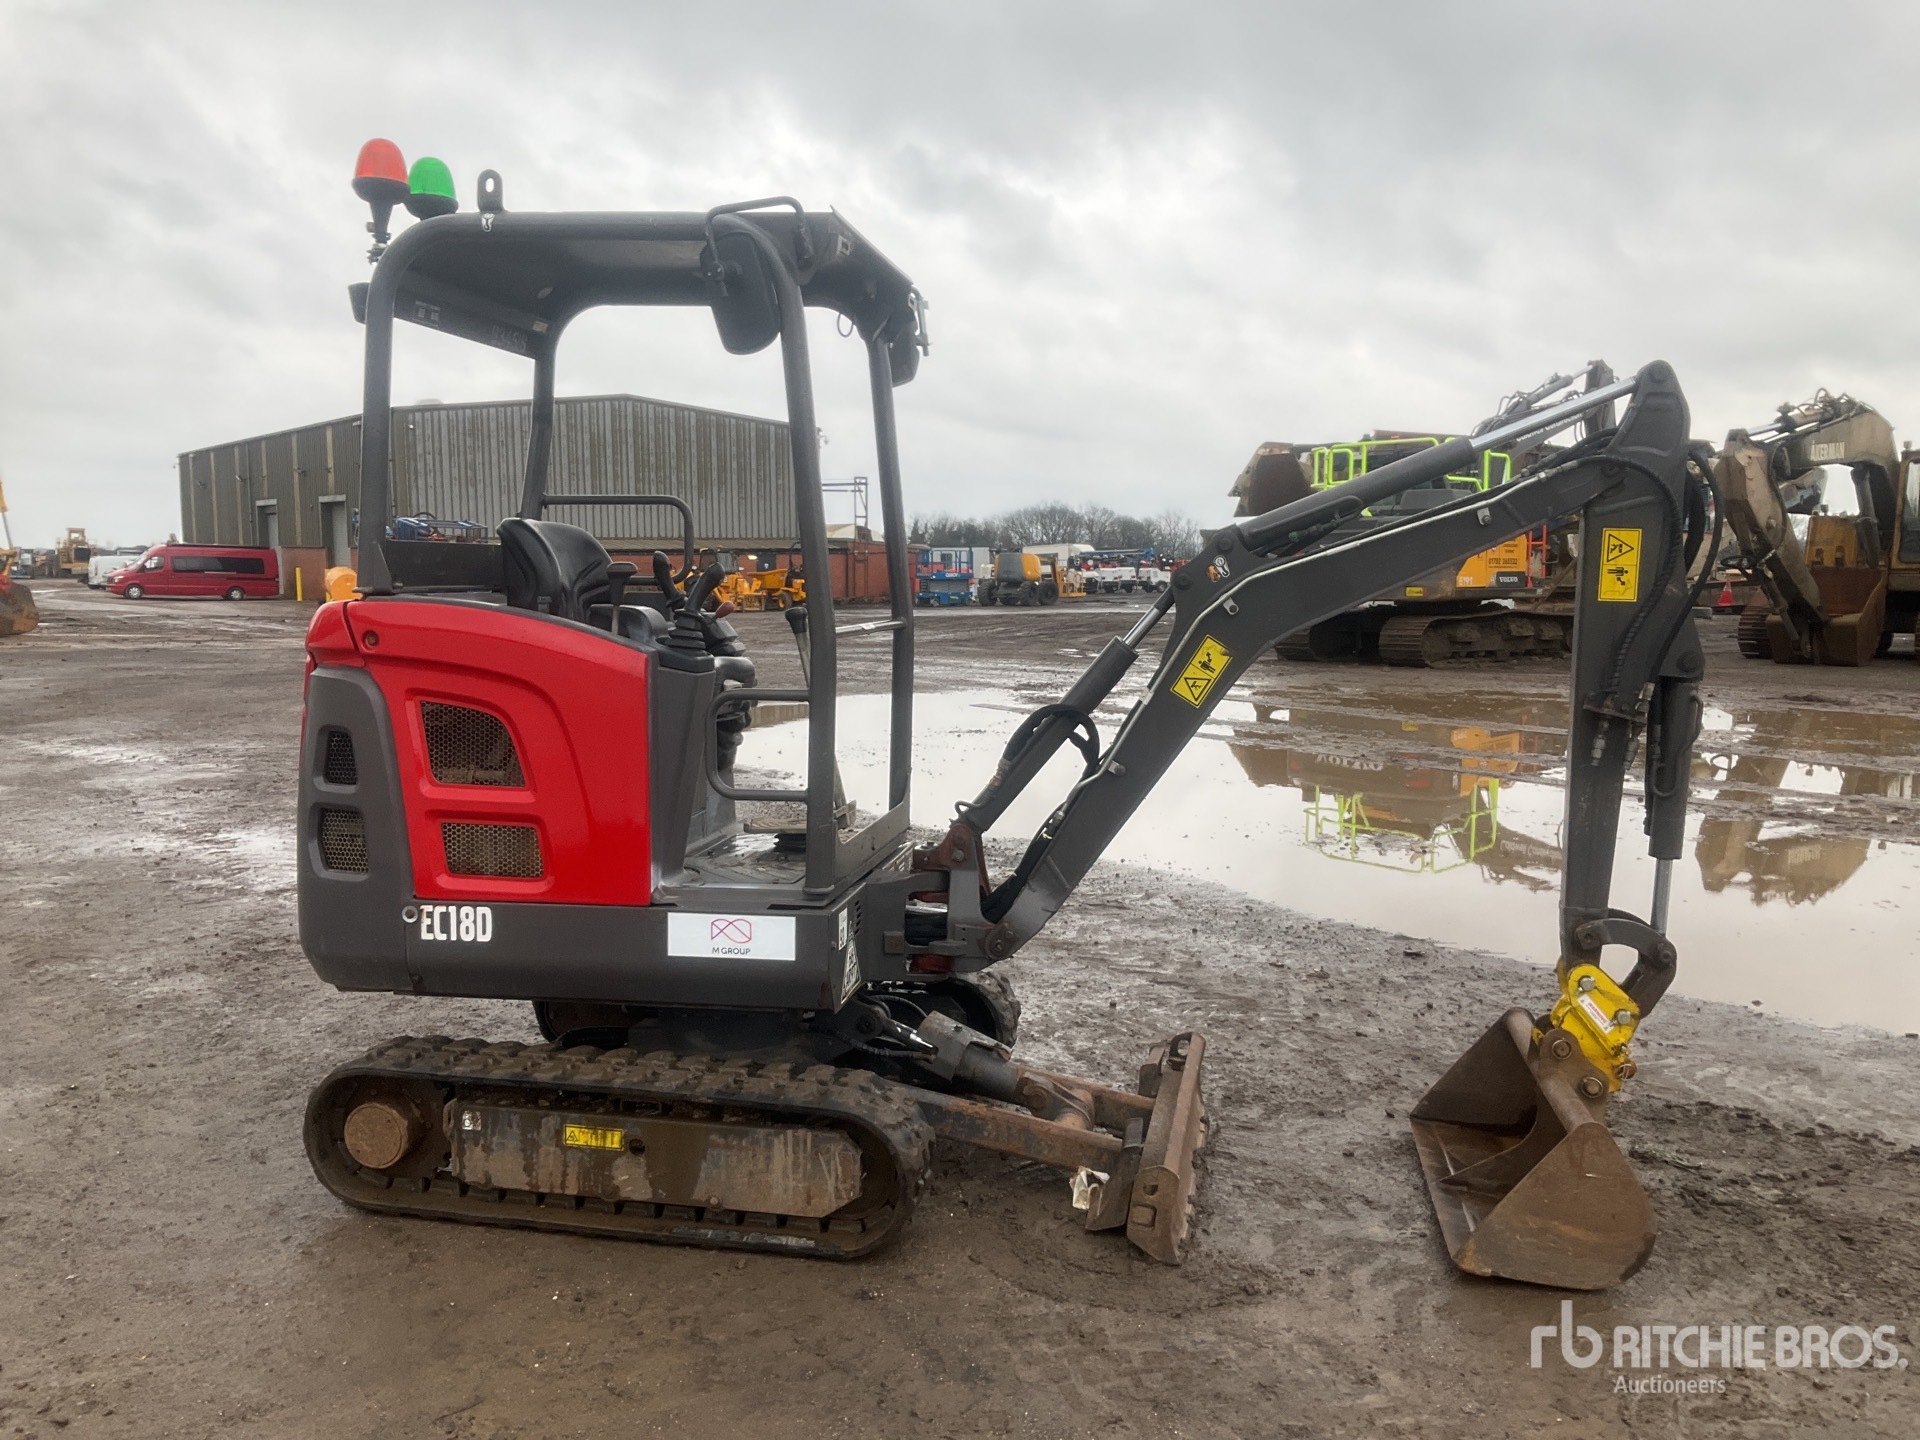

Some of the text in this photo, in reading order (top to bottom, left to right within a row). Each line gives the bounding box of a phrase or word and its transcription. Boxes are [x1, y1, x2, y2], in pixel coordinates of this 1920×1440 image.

[420, 905, 493, 942] EC18D
[711, 946, 751, 955] M GROUP
